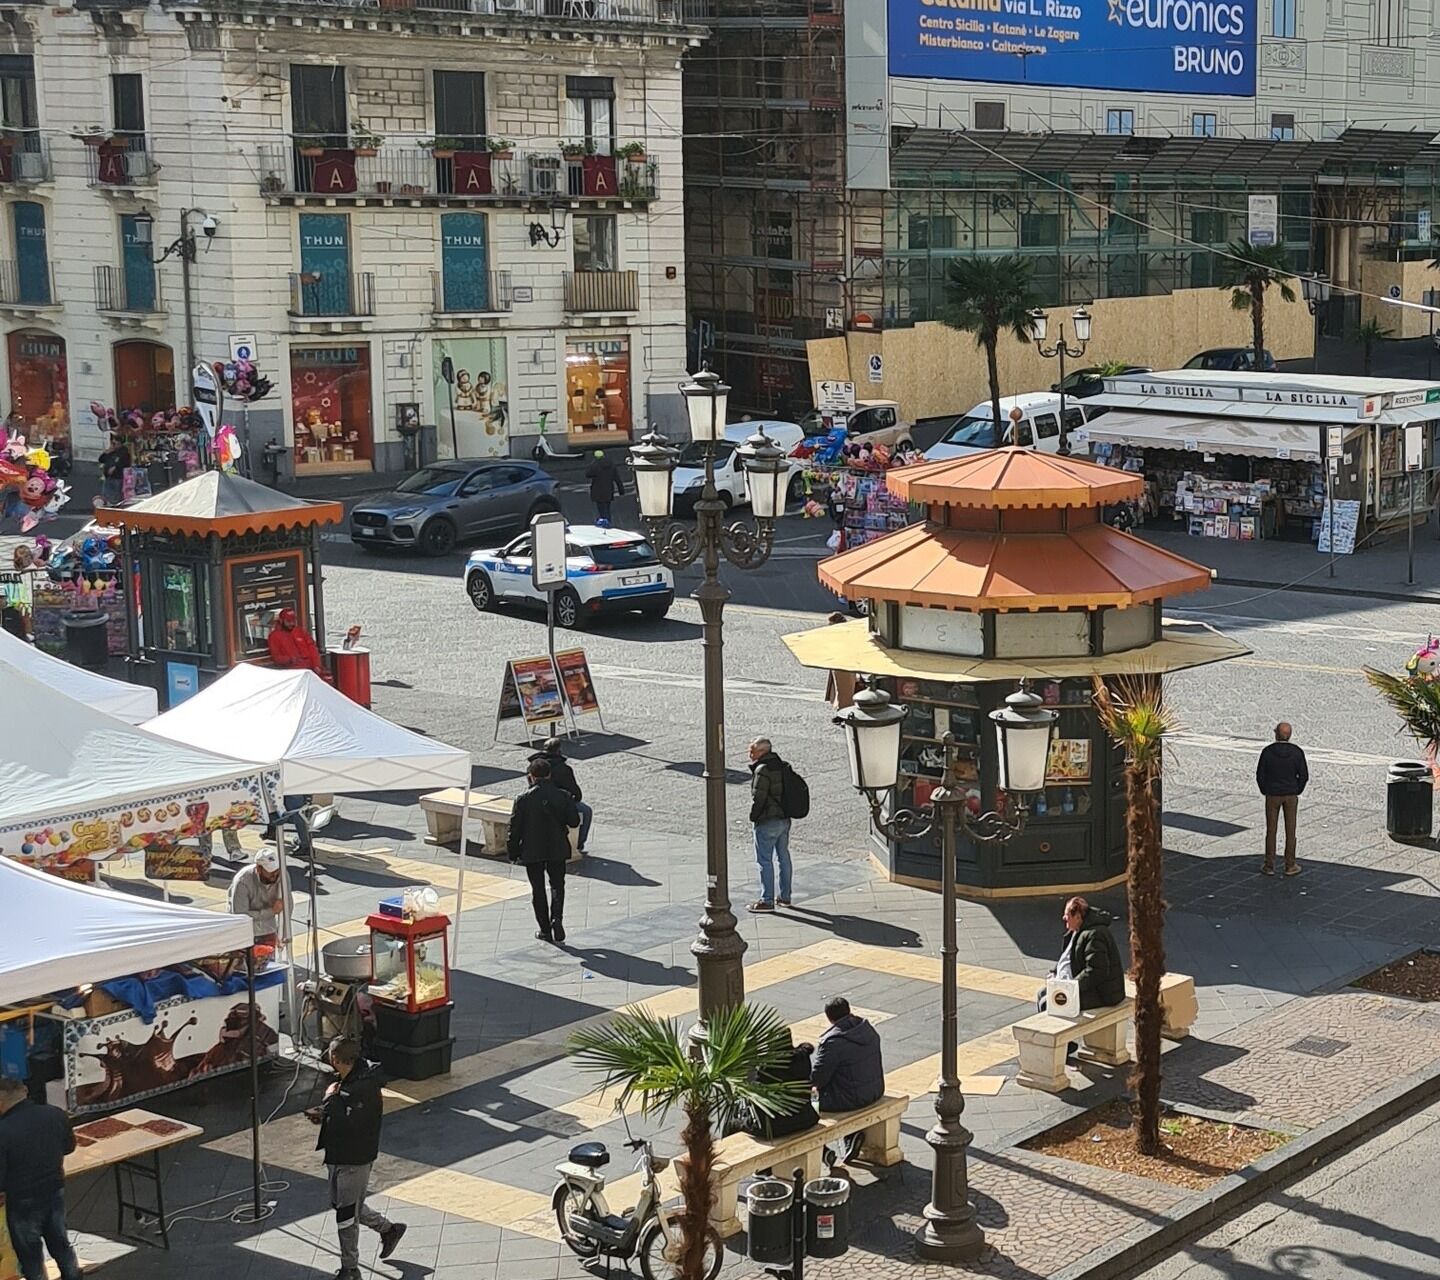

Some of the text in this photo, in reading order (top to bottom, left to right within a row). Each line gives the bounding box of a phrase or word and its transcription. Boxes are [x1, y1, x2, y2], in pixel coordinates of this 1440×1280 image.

[1046, 0, 1082, 20] Rizzo
[919, 15, 953, 31] Centro
[955, 17, 985, 33] Sicilia
[1034, 25, 1047, 38] Le
[1047, 26, 1080, 43] Zagare
[919, 33, 984, 50] Misterbianco
[1174, 46, 1244, 75] BRUNO
[329, 168, 344, 189] A
[467, 169, 480, 189] A
[595, 171, 608, 191] A
[304, 236, 344, 246] THUN
[445, 236, 482, 246] THUN
[301, 348, 358, 361] THUN
[575, 341, 622, 353] THUN
[1141, 384, 1214, 398] LA SICILIA
[1266, 392, 1348, 406] LA SICILIA
